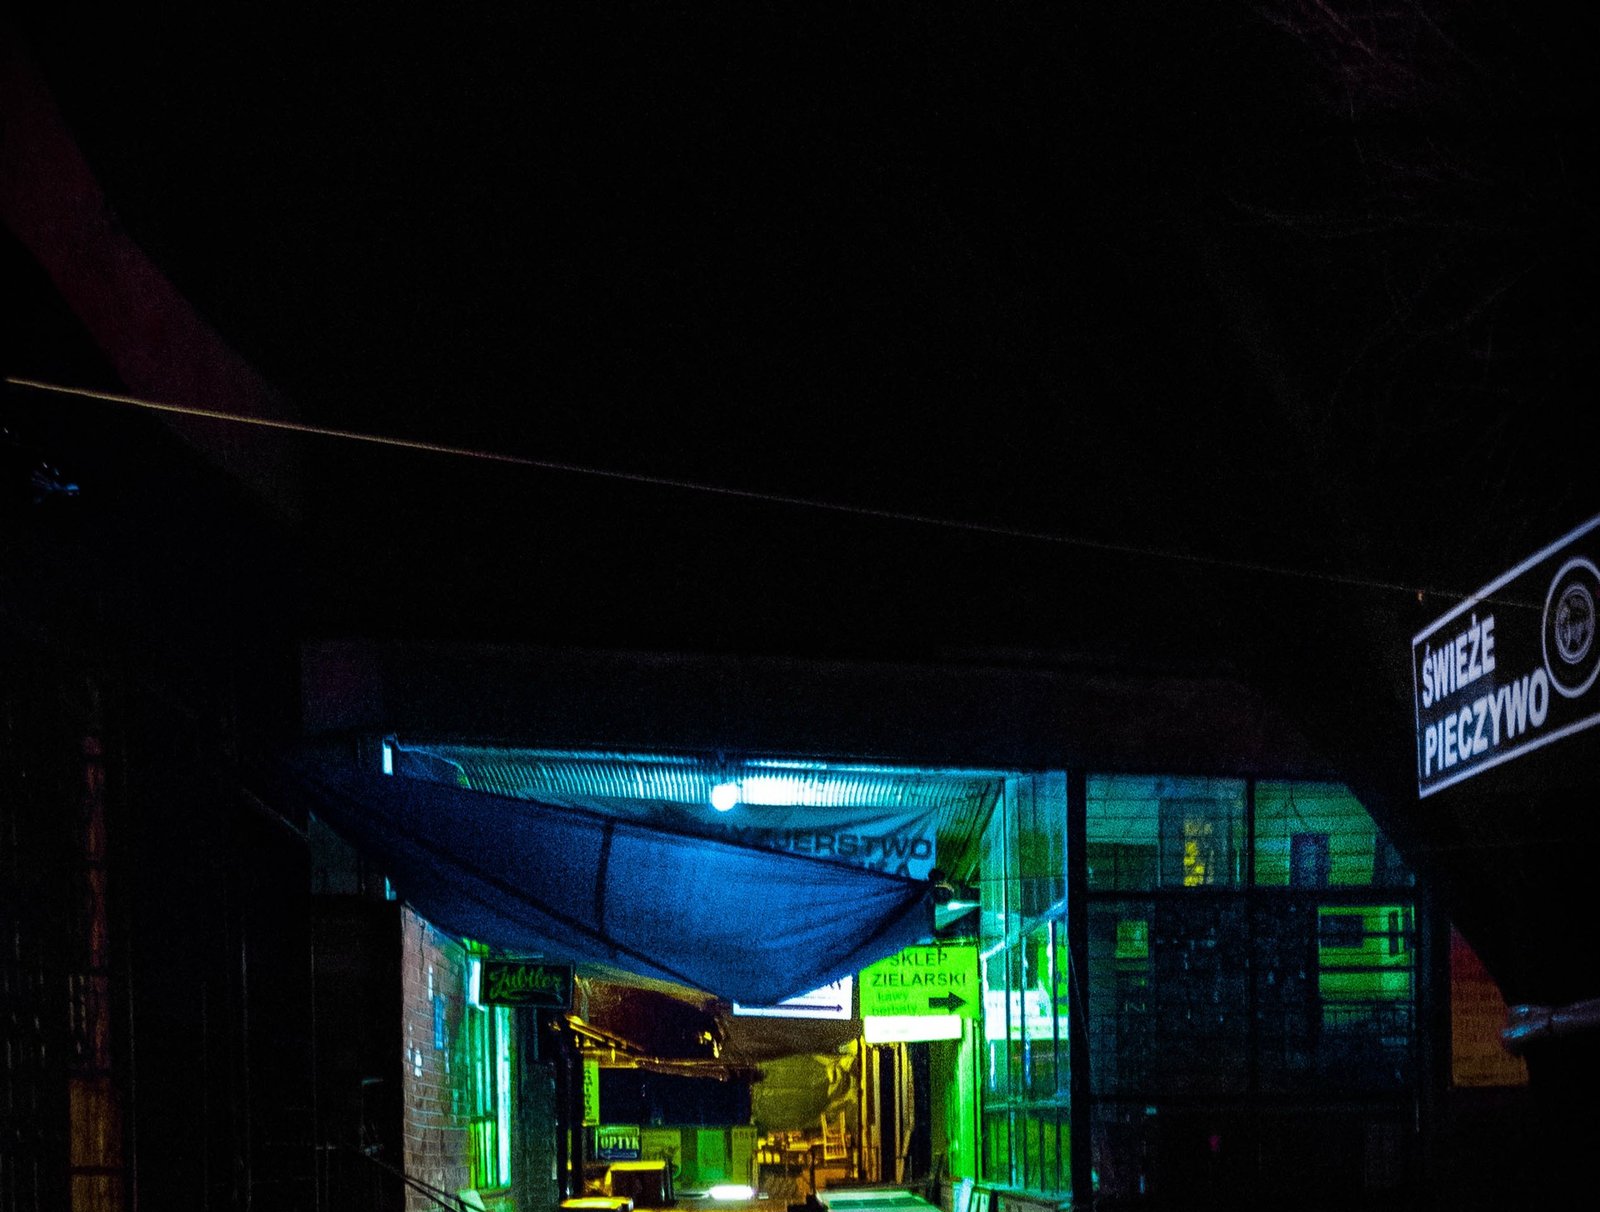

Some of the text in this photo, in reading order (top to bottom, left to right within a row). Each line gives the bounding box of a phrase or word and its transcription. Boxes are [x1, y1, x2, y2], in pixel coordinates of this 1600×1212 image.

[1421, 612, 1496, 709] ŚWIEŻE
[1424, 666, 1549, 778] PIECZYWO
[889, 952, 948, 967] SKLEP
[872, 972, 966, 987] ZIELARSKI
[600, 1136, 640, 1150] OPTYK
